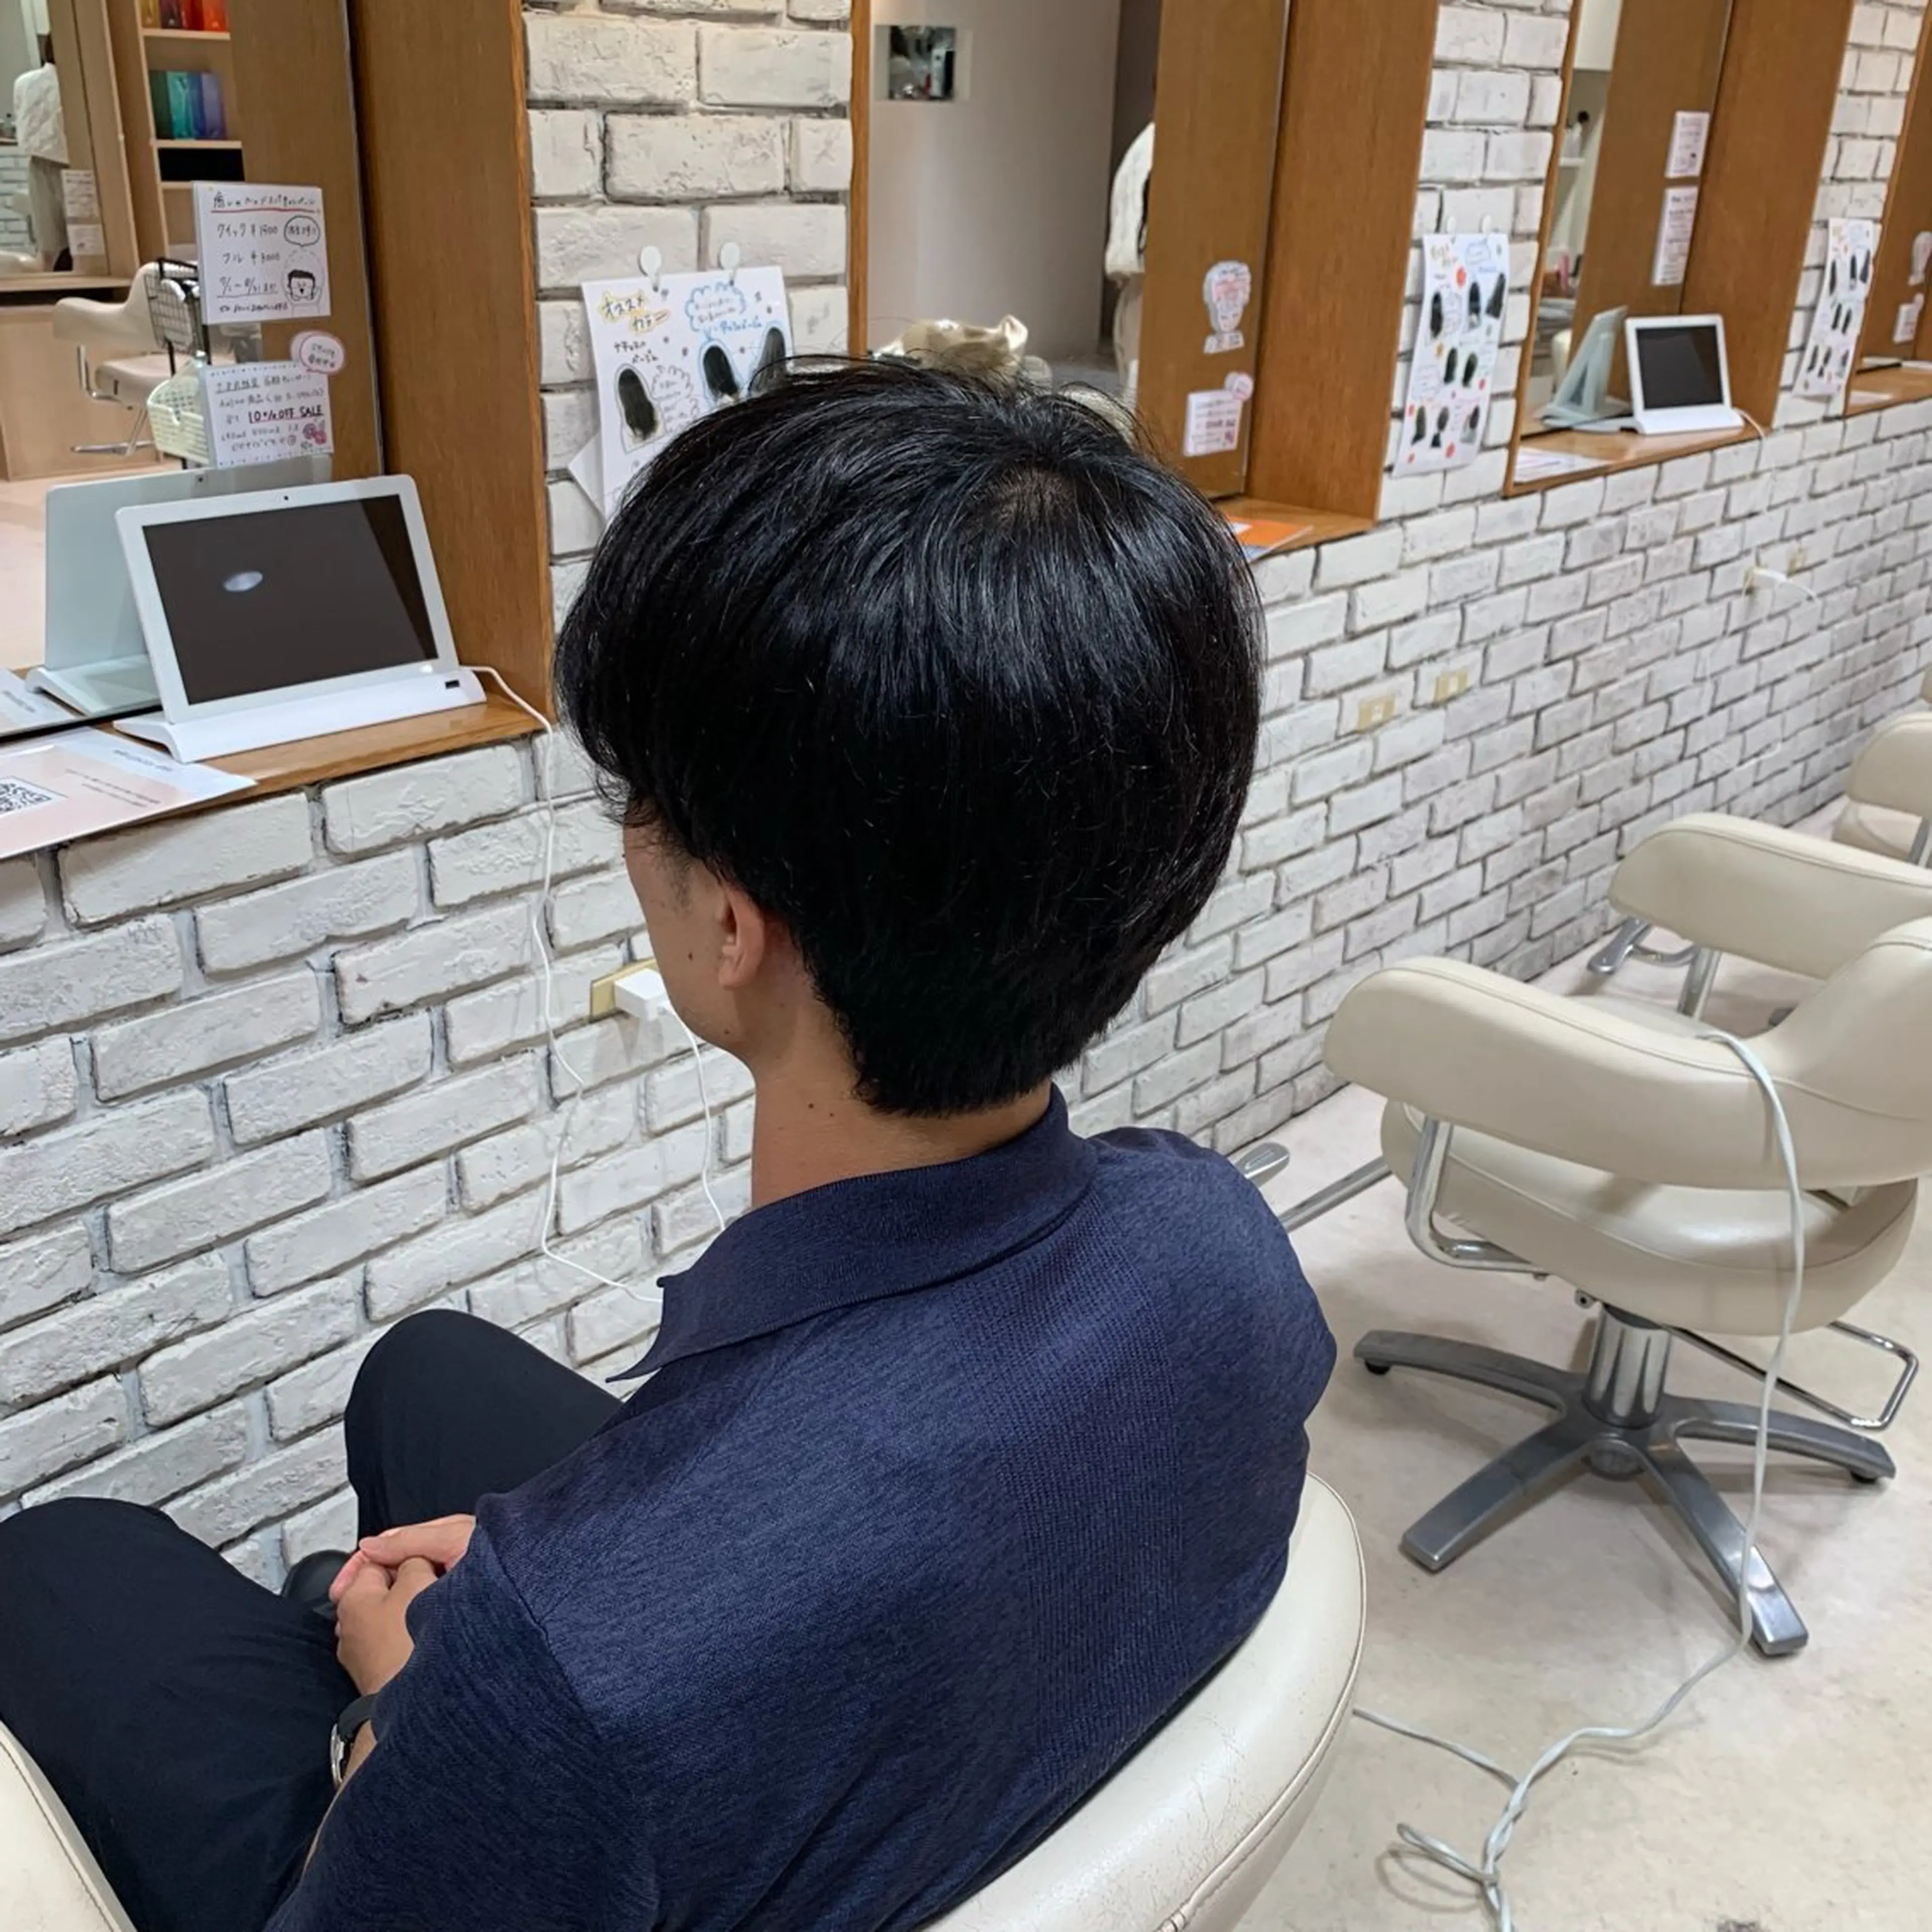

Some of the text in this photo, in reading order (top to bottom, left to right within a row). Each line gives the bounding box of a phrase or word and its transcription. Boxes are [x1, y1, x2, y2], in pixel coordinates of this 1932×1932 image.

[217, 223, 246, 238] クイック
[299, 404, 325, 418] SALE
